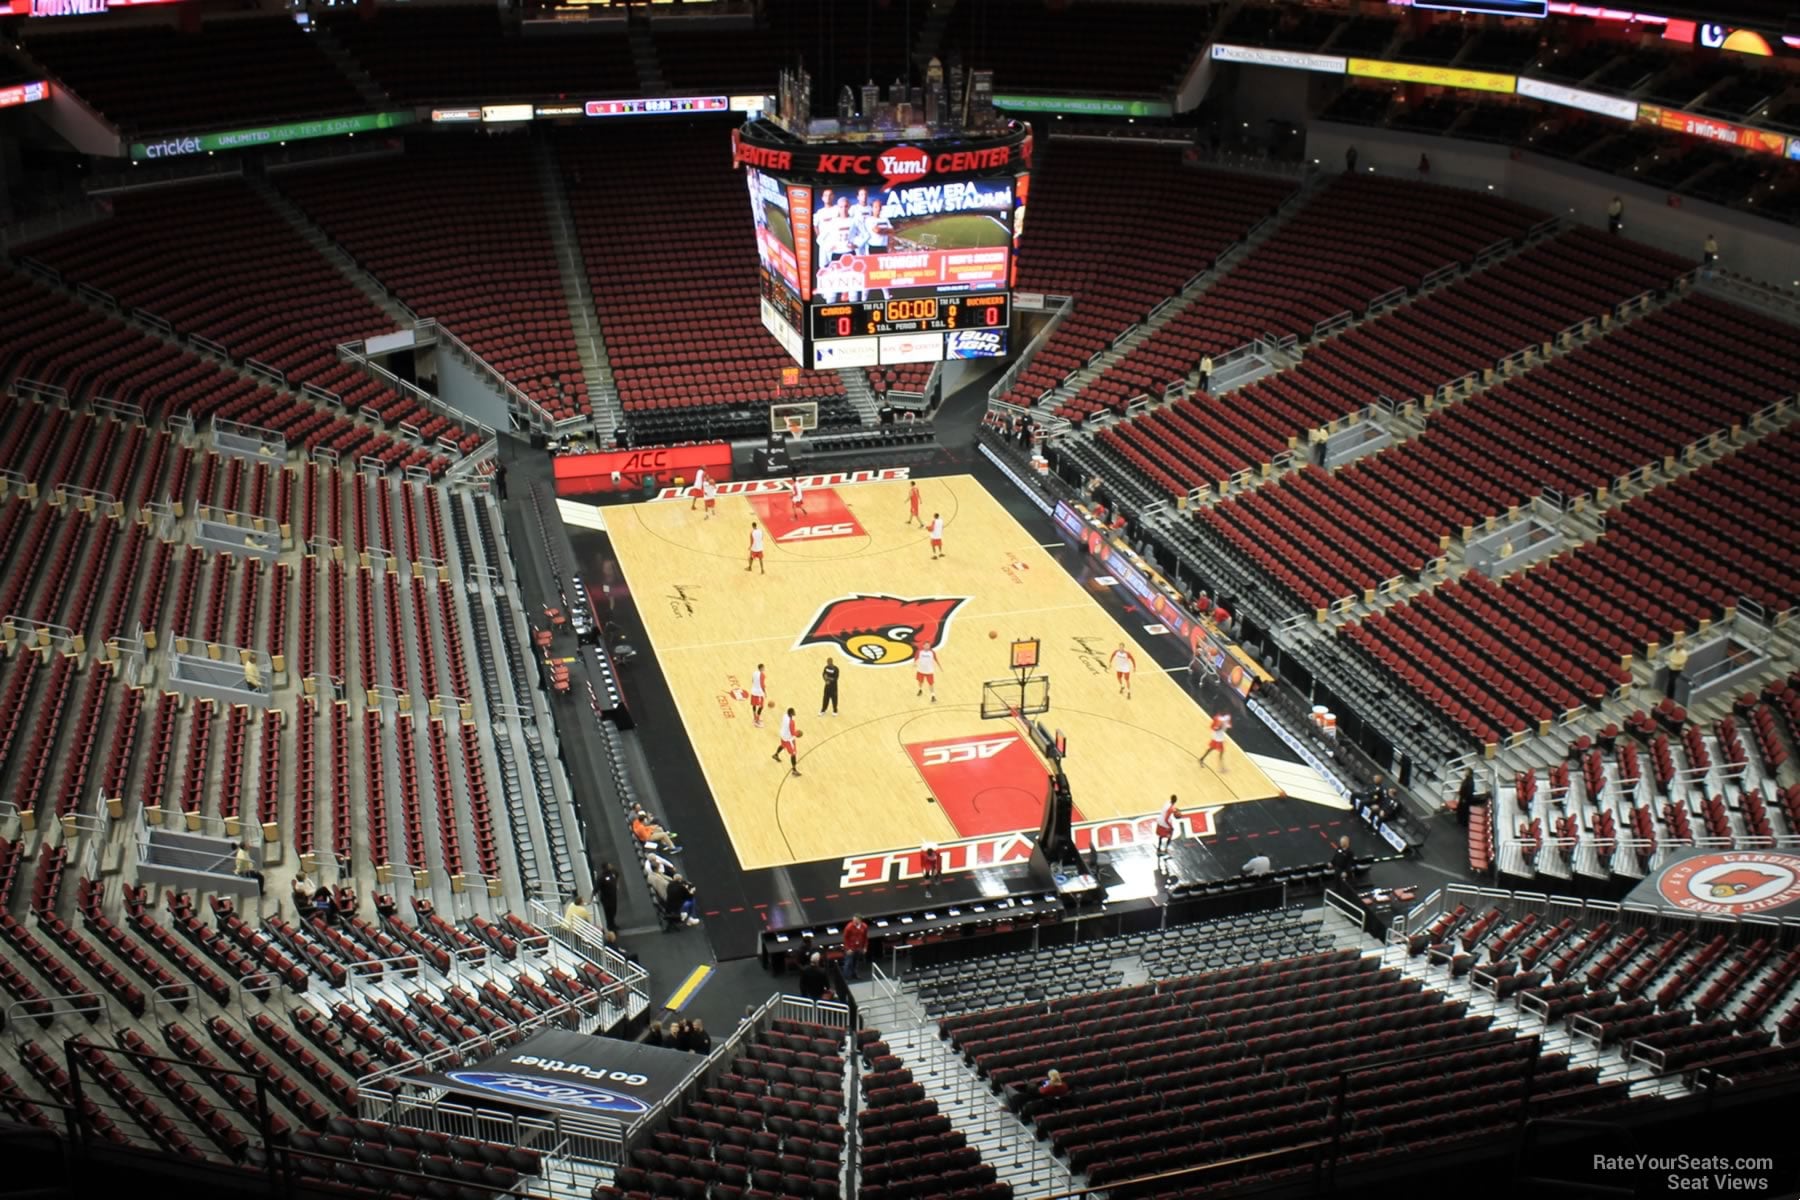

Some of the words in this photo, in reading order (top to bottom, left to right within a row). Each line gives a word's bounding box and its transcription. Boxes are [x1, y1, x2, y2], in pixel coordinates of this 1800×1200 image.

[218, 131, 270, 146] UNLIMITED
[1686, 120, 1695, 134] a
[1695, 120, 1738, 144] win-win
[145, 136, 202, 158] cricket
[816, 154, 871, 174] KFC
[879, 154, 929, 176] Yum!
[935, 146, 1010, 173] CENTER
[886, 190, 901, 206] A
[901, 185, 941, 204] NEW
[943, 181, 977, 200] ERA
[906, 198, 943, 217] NEW
[877, 254, 930, 270] TONIGHT
[819, 274, 865, 290] LYNN
[821, 306, 852, 316] CARDS
[872, 310, 881, 322] 0
[888, 299, 936, 320] 60:00
[949, 305, 957, 317] 0
[986, 307, 998, 325] 0
[838, 317, 851, 336] 0
[895, 322, 917, 330] PERIOD
[959, 331, 1000, 343] BUD
[838, 346, 875, 355] NORTON
[953, 340, 1001, 353] LIGHT
[622, 450, 668, 471] ACC
[776, 522, 854, 540] ACC
[920, 736, 1020, 767] ACC
[1679, 898, 1734, 914] FUND
[510, 1054, 608, 1082] Further
[608, 1071, 649, 1087] Go
[483, 1077, 616, 1107] Ford
